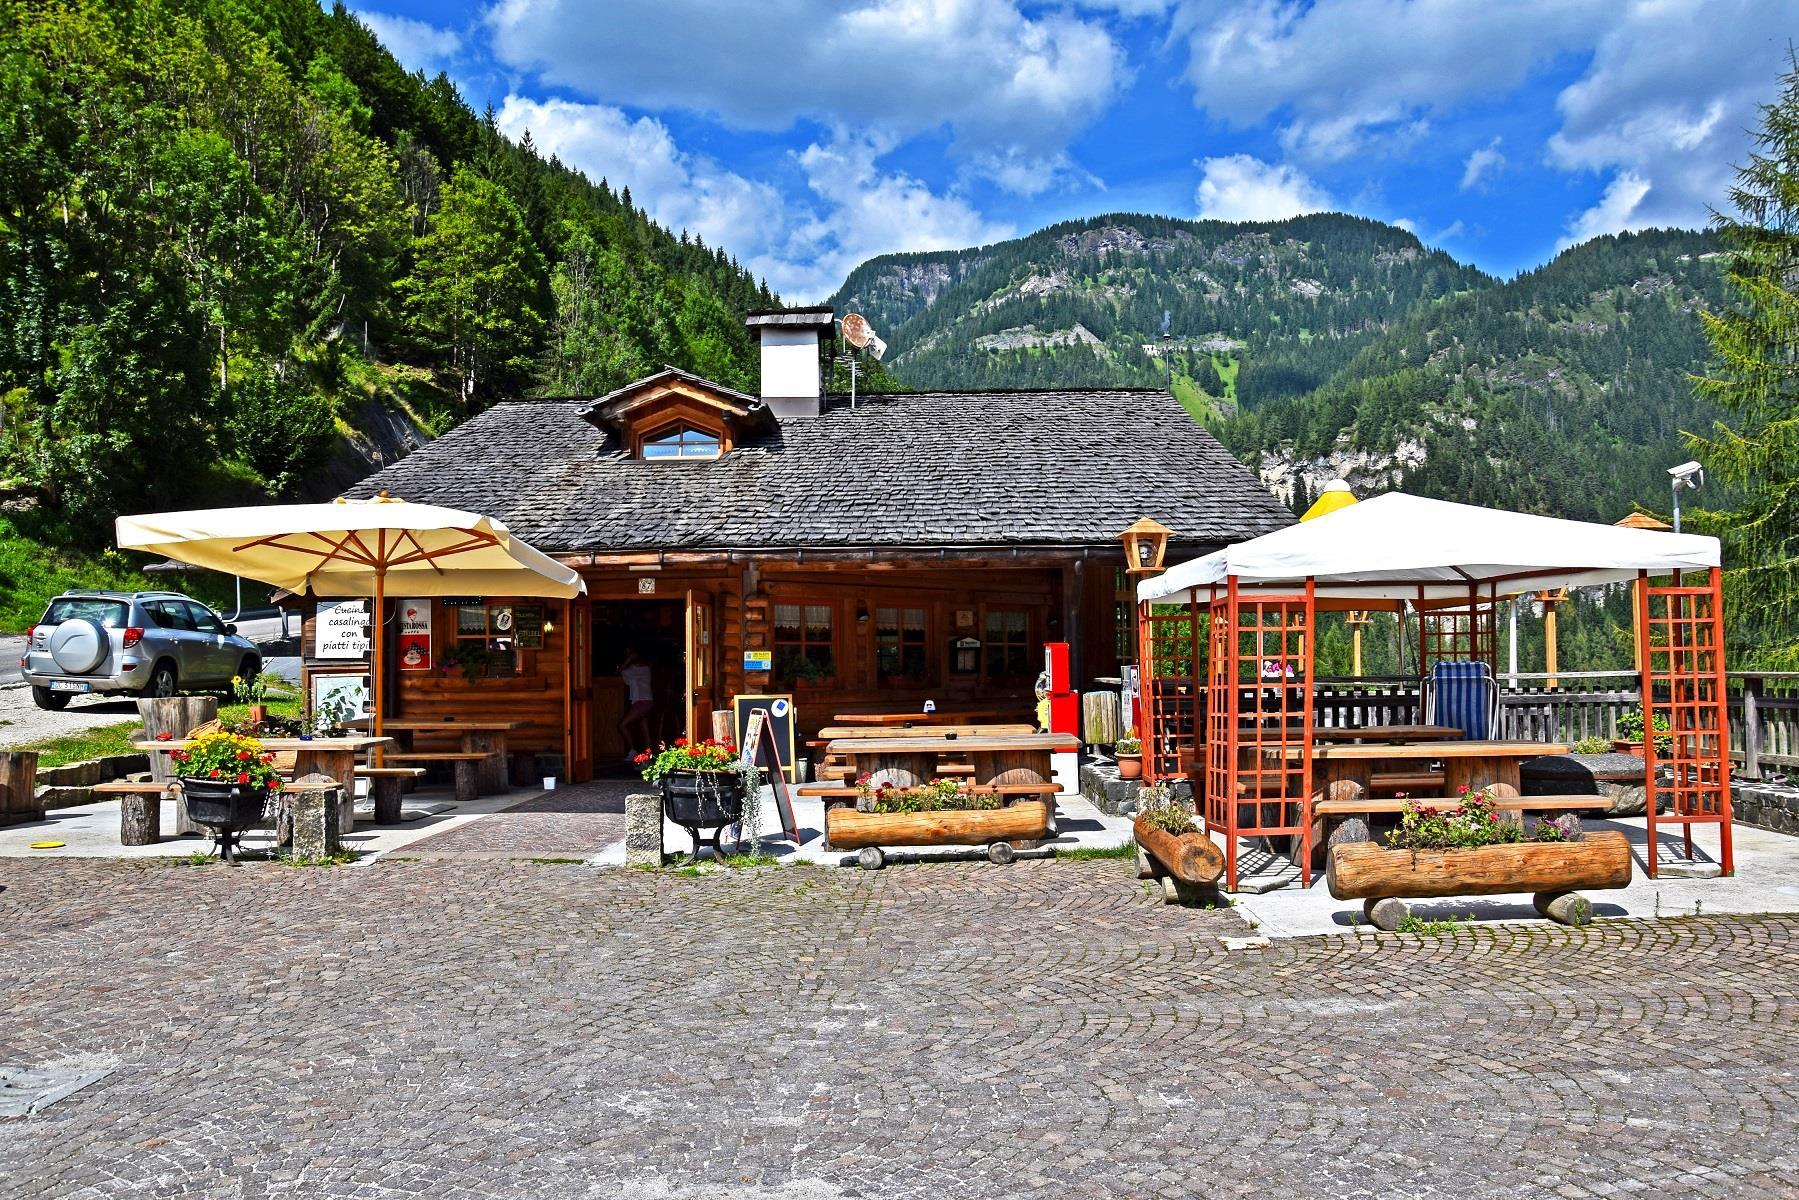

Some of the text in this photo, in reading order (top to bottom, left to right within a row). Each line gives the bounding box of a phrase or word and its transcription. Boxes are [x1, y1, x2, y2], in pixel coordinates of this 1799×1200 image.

[328, 617, 370, 629] casalinga
[323, 641, 369, 653] piatti tipi
